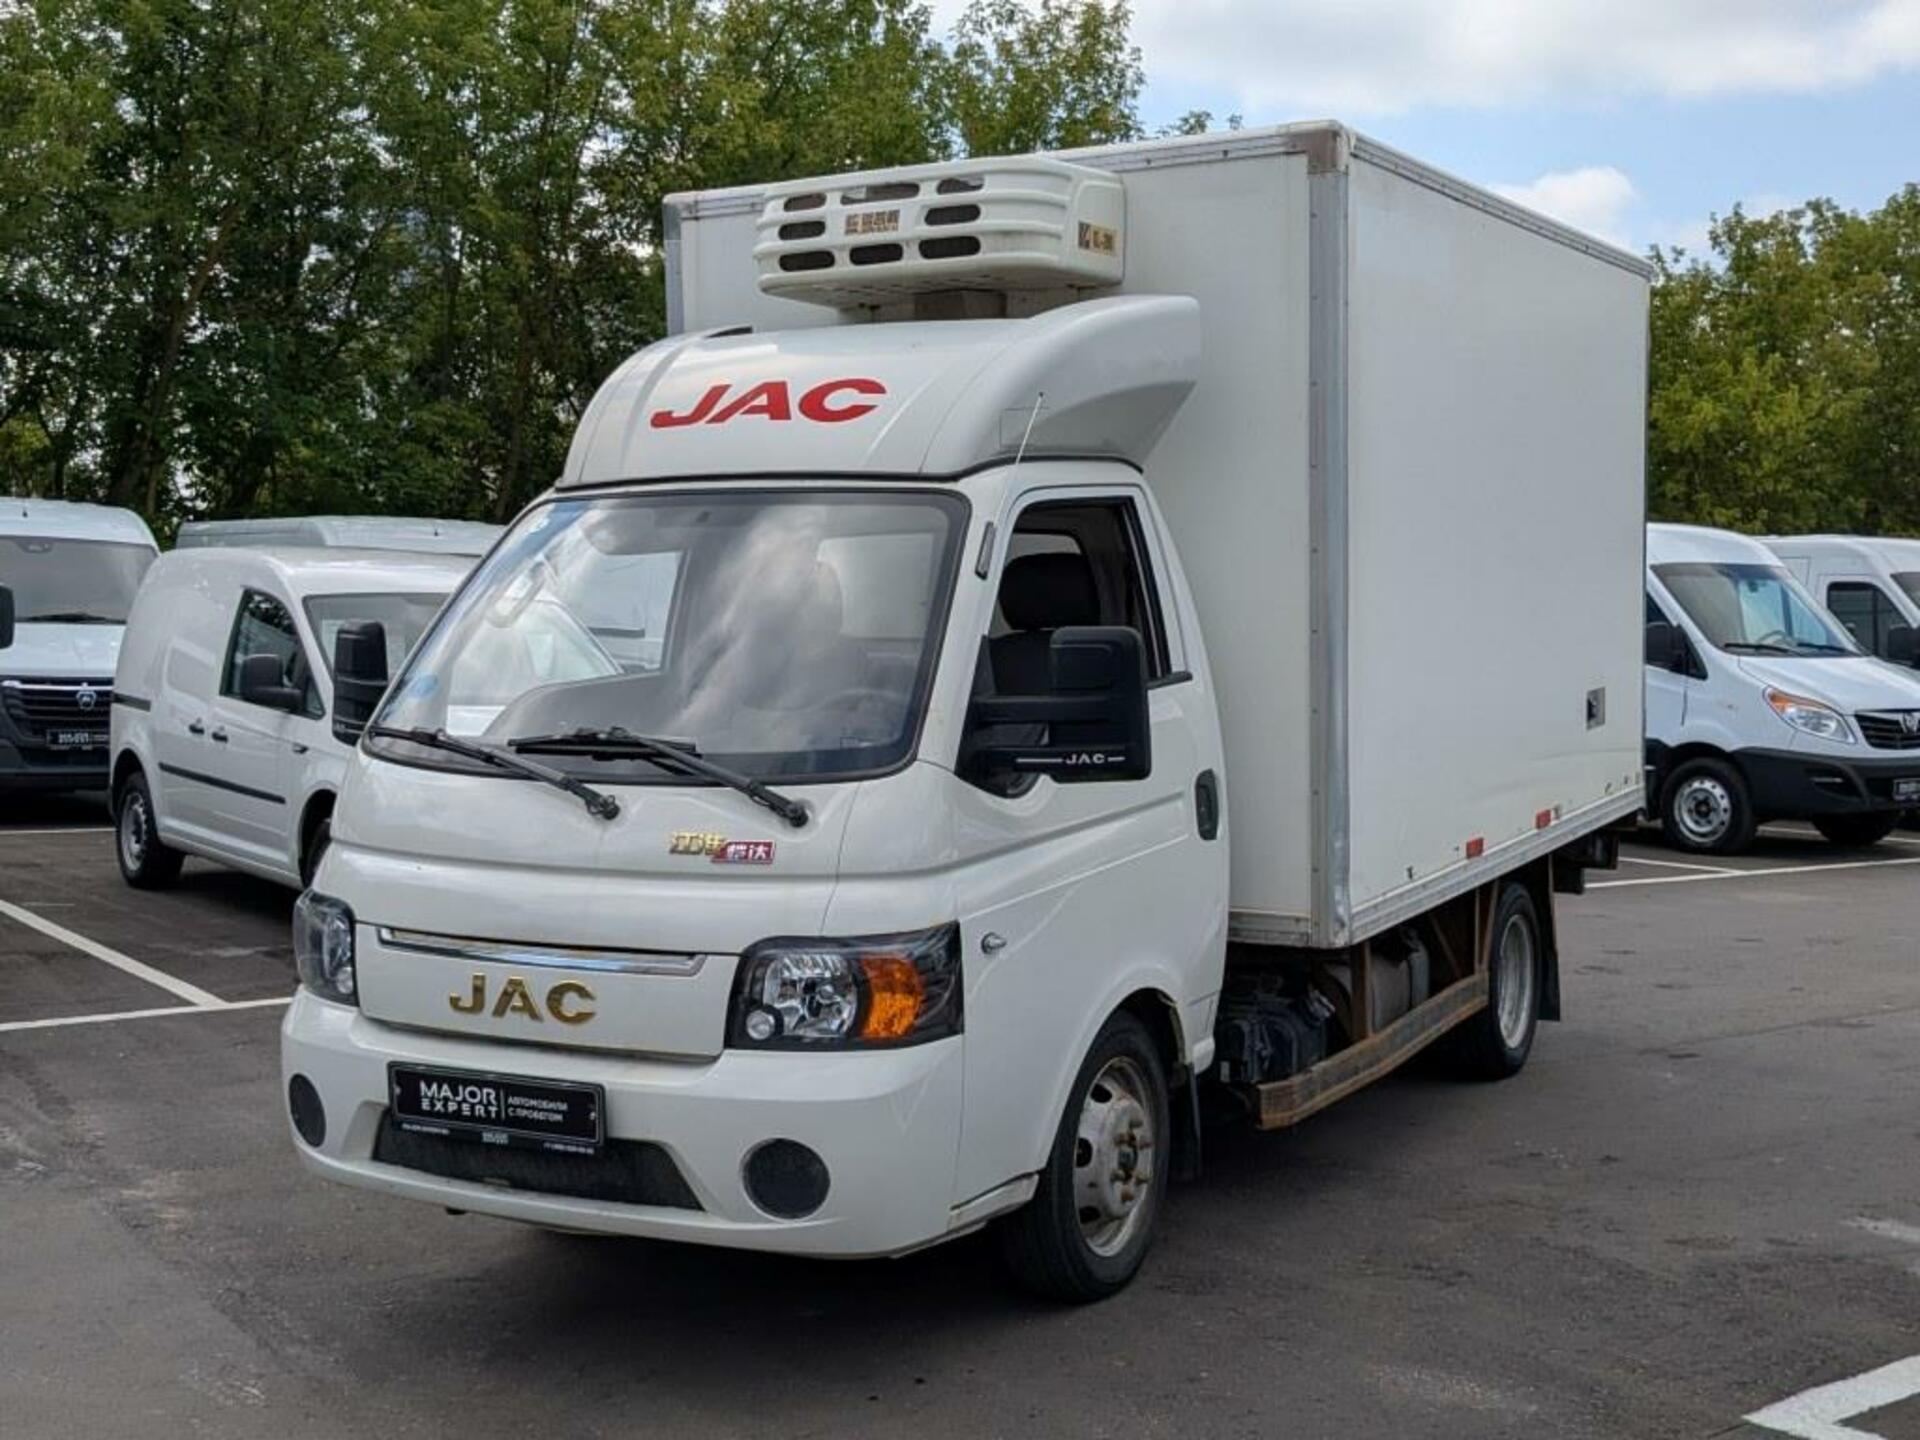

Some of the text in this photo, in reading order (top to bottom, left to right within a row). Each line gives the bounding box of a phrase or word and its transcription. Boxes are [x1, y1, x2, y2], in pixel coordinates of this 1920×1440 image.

[650, 378, 886, 428] JAC
[1065, 753, 1105, 765] JAC
[450, 972, 597, 1025] JAC
[419, 1080, 497, 1105] MAJOR
[421, 1098, 499, 1119] EXPERT
